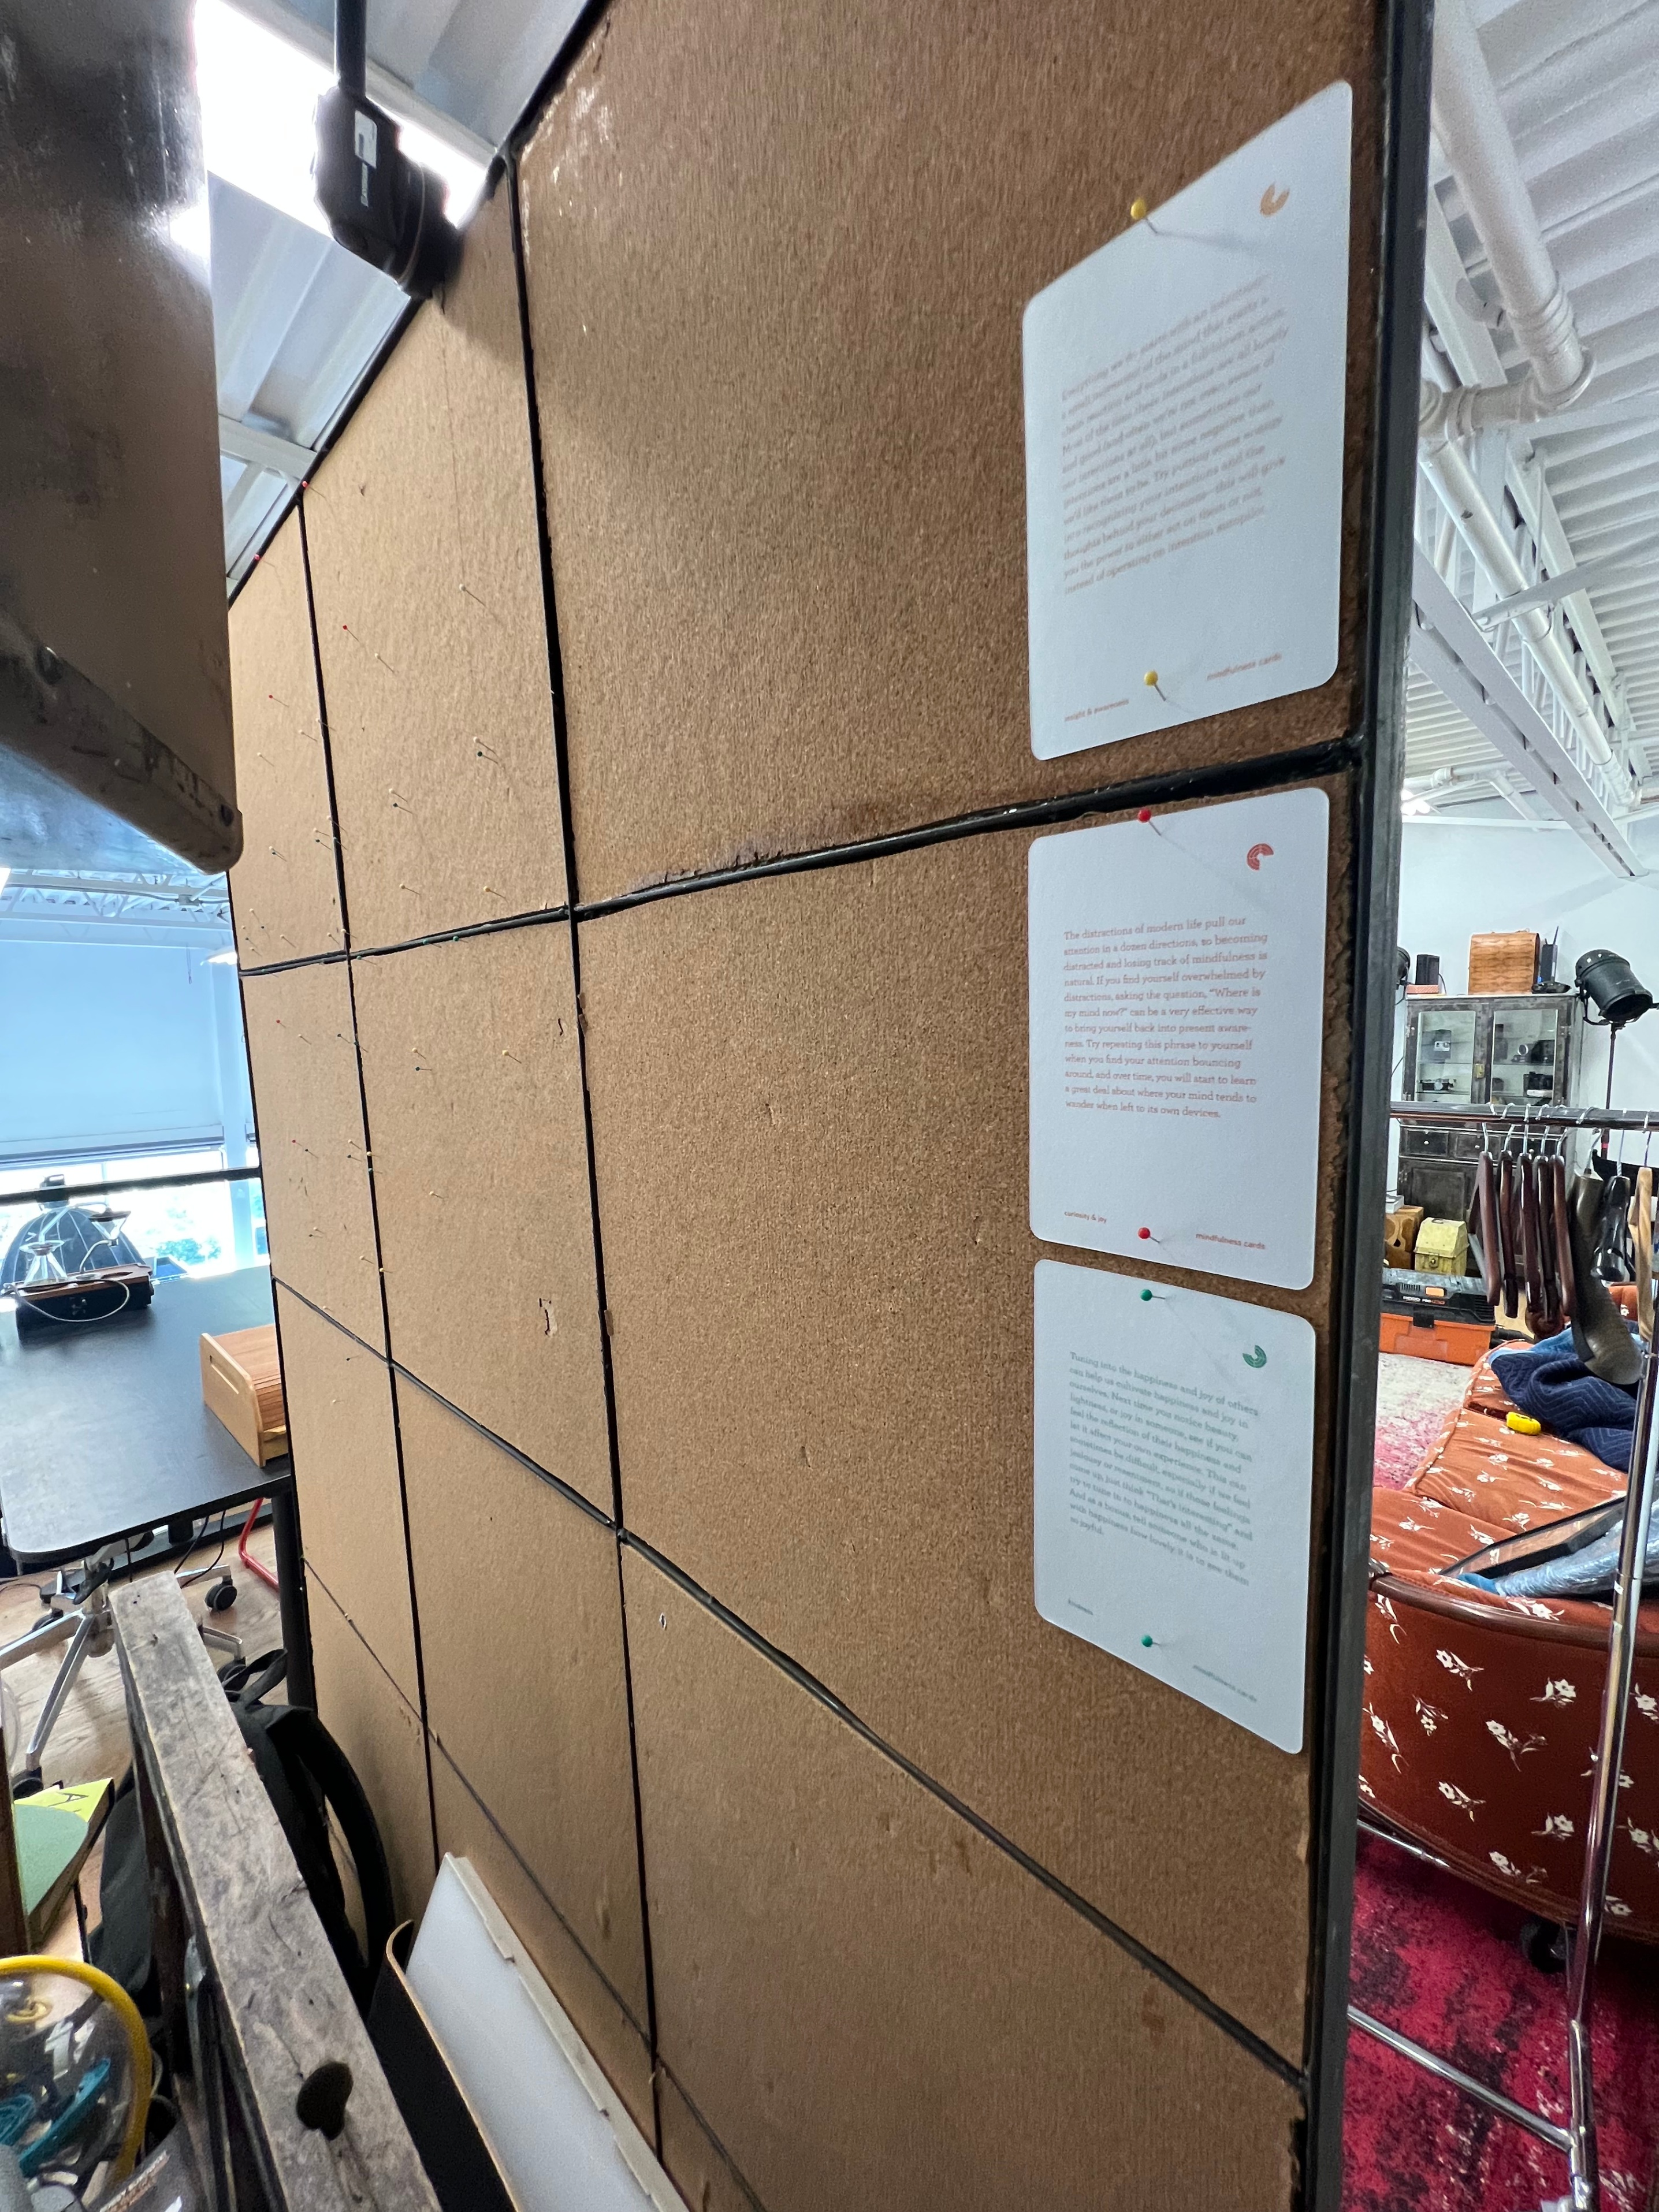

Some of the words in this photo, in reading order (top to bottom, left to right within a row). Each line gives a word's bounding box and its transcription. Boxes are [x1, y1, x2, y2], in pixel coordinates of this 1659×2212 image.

[1064, 930, 1079, 940] The
[1083, 926, 1132, 938] distractions
[1135, 924, 1144, 934] of
[1147, 922, 1183, 933] modern
[1186, 919, 1202, 930] life
[1205, 917, 1225, 931] pull
[1229, 918, 1245, 926] our
[1064, 945, 1099, 955] attention
[1102, 944, 1110, 952] in
[1121, 942, 1146, 951] dozen
[1215, 933, 1267, 945] becoming
[1063, 959, 1103, 970] distracted
[1106, 959, 1121, 968] and
[1124, 958, 1151, 969] losing
[1154, 955, 1176, 966] track
[1180, 955, 1189, 965] of
[1192, 952, 1255, 964] mindfulness
[1259, 950, 1267, 960] is
[1096, 975, 1103, 985] If
[1106, 978, 1120, 986] you
[1123, 974, 1139, 984] find
[1143, 972, 1179, 985] yourself
[1182, 969, 1249, 981] overwhelmed
[1252, 969, 1265, 981] by
[1115, 990, 1143, 1001] asking
[1147, 990, 1160, 999] the
[1252, 986, 1260, 997] is
[1065, 1010, 1076, 1018] my
[1079, 1007, 1100, 1016] mind
[1147, 1006, 1158, 1015] be
[1169, 1009, 1189, 1018] very
[1192, 1005, 1234, 1015] effective
[1237, 1008, 1257, 1017] way
[1074, 1023, 1096, 1034] bring
[1099, 1023, 1132, 1034] yourself
[1134, 1023, 1154, 1031] back
[1158, 1023, 1176, 1032] into
[1179, 1024, 1214, 1034] present
[1087, 1038, 1099, 1049] Try
[1102, 1039, 1142, 1051] repeating
[1145, 1039, 1161, 1048] this
[1164, 1040, 1195, 1051] phrase
[1199, 1041, 1207, 1049] to
[1211, 1040, 1252, 1052] yourself
[1065, 1053, 1085, 1062] when
[1089, 1056, 1103, 1065] you
[1106, 1054, 1122, 1063] find
[1125, 1057, 1144, 1066] your
[1147, 1056, 1189, 1066] attention
[1192, 1056, 1241, 1070] bouncing
[1096, 1070, 1110, 1079] and
[1156, 1075, 1171, 1083] you
[1175, 1073, 1191, 1082] will
[1194, 1075, 1214, 1083] start
[1218, 1076, 1227, 1084] to
[1230, 1075, 1256, 1086] learn
[1072, 1086, 1090, 1094] great
[1093, 1085, 1109, 1094] deal
[1112, 1086, 1134, 1096] about
[1137, 1088, 1163, 1097] where
[1166, 1092, 1185, 1101] your
[1188, 1090, 1213, 1101] mind
[1215, 1092, 1243, 1103] tends
[1246, 1094, 1256, 1103] to
[1066, 1099, 1093, 1108] wander
[1097, 1101, 1117, 1111] when
[1121, 1102, 1133, 1112] left
[1136, 1104, 1144, 1112] to
[1148, 1104, 1158, 1114] its
[1064, 1210, 1089, 1221] curiosity
[1098, 1216, 1107, 1224] joy
[1196, 1233, 1242, 1246] mindfulness
[1244, 1241, 1266, 1250] cards
